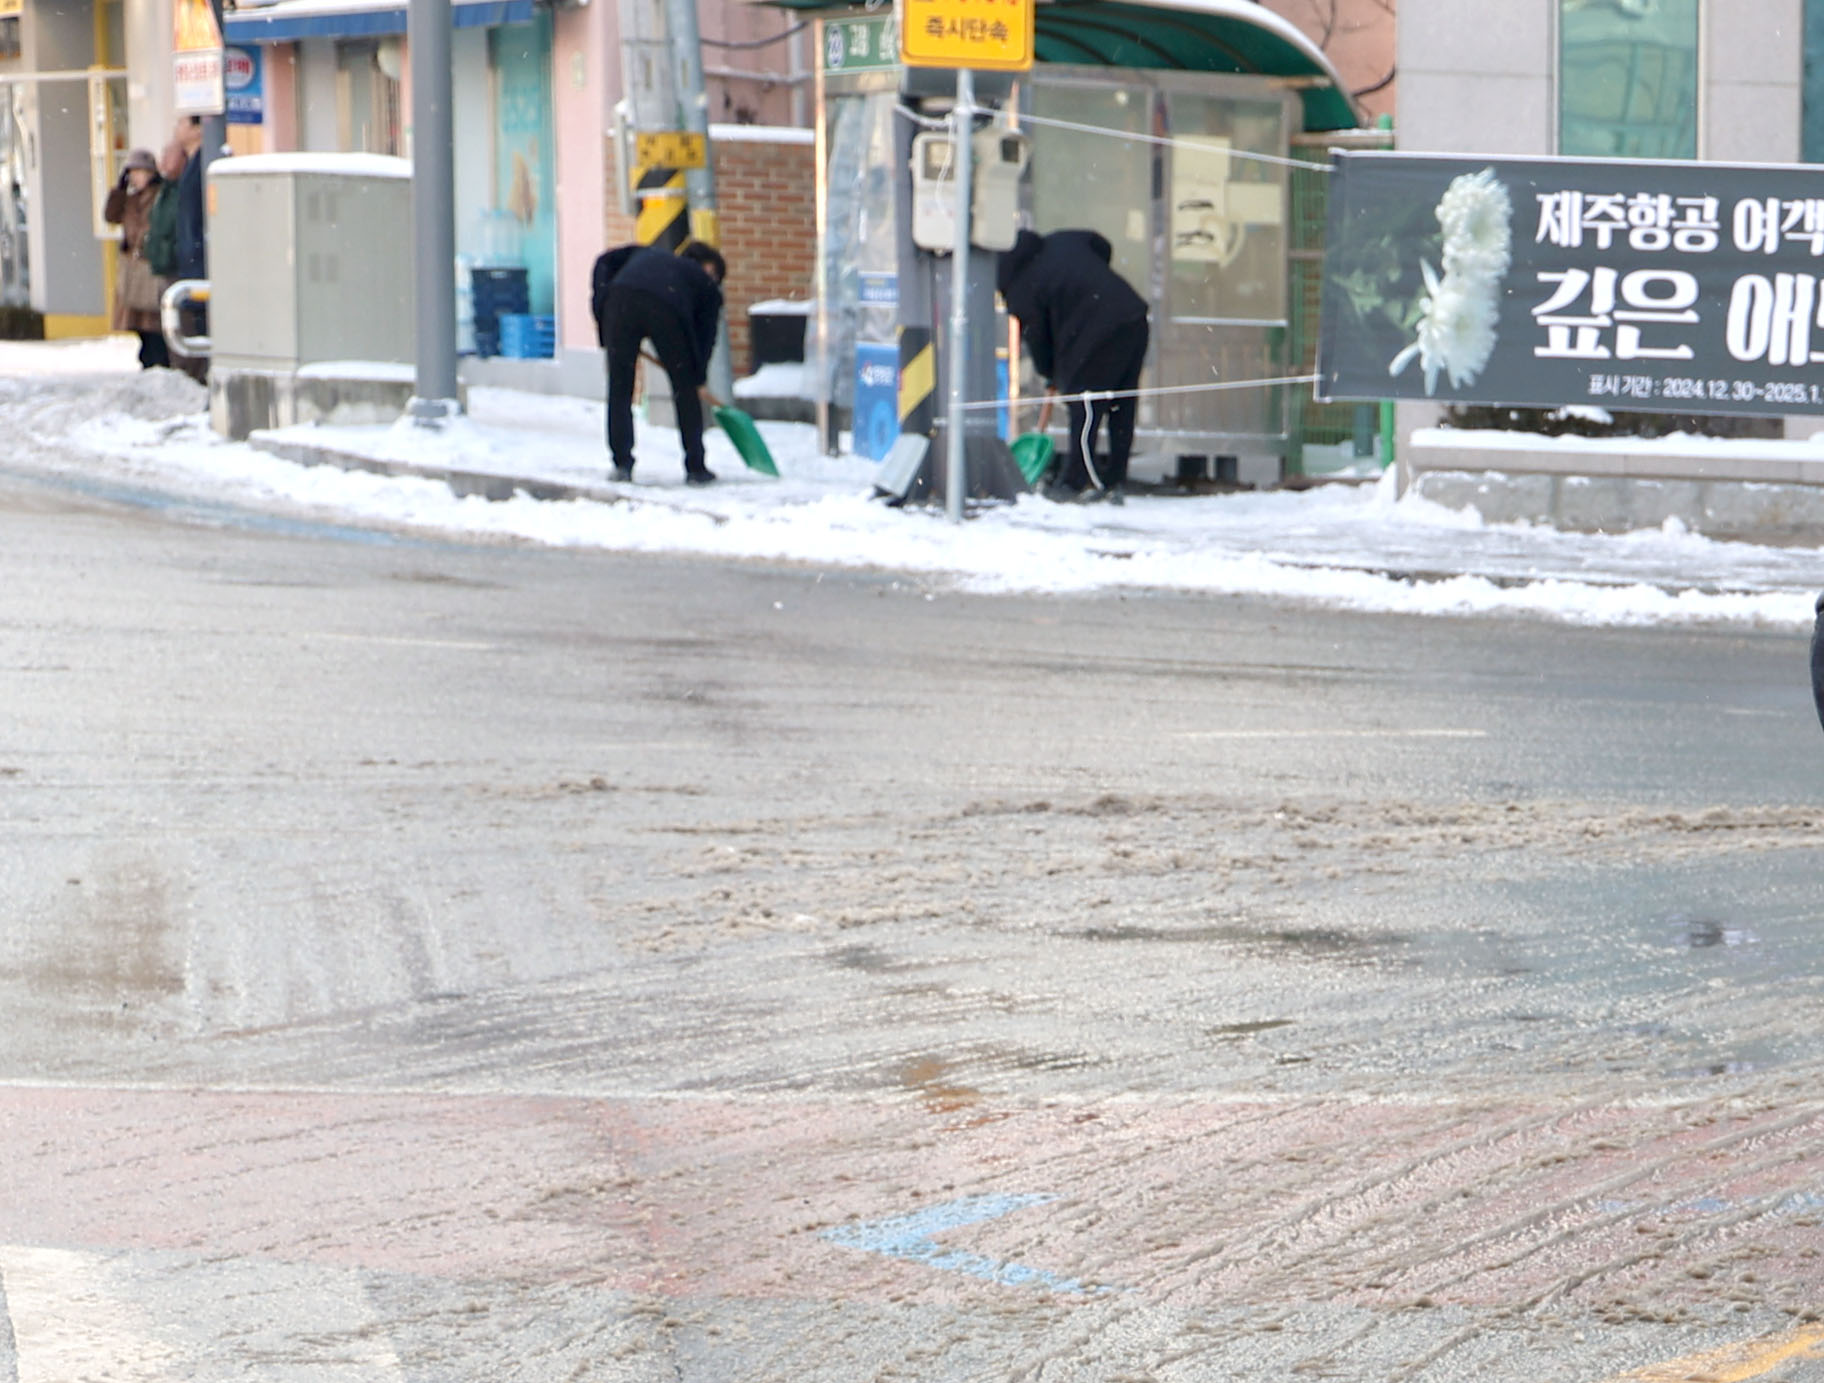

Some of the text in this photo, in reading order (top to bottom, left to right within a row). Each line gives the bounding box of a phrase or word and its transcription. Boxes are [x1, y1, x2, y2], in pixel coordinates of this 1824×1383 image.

[925, 15, 1008, 43] 즉시단속
[1535, 190, 1720, 252] 제주항공
[1531, 266, 1700, 360] 깊은
